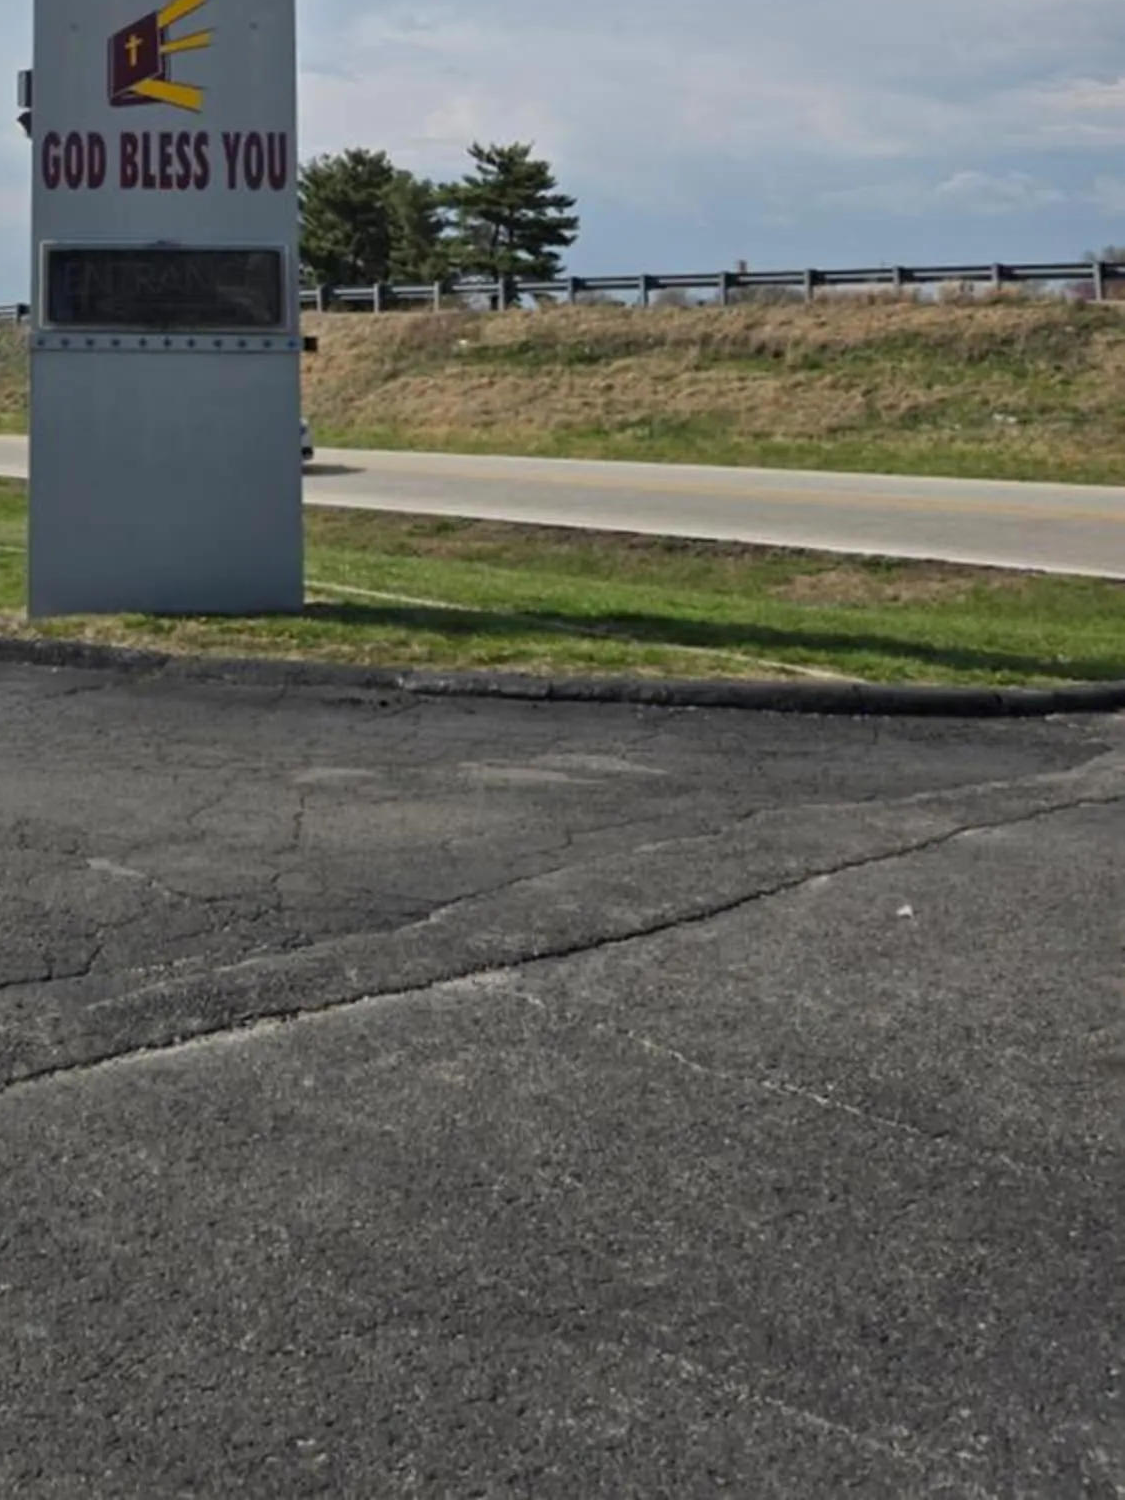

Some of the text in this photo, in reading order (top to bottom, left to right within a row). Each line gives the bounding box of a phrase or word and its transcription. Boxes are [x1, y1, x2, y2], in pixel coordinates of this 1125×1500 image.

[42, 131, 288, 191] GOD BLESS YOU
